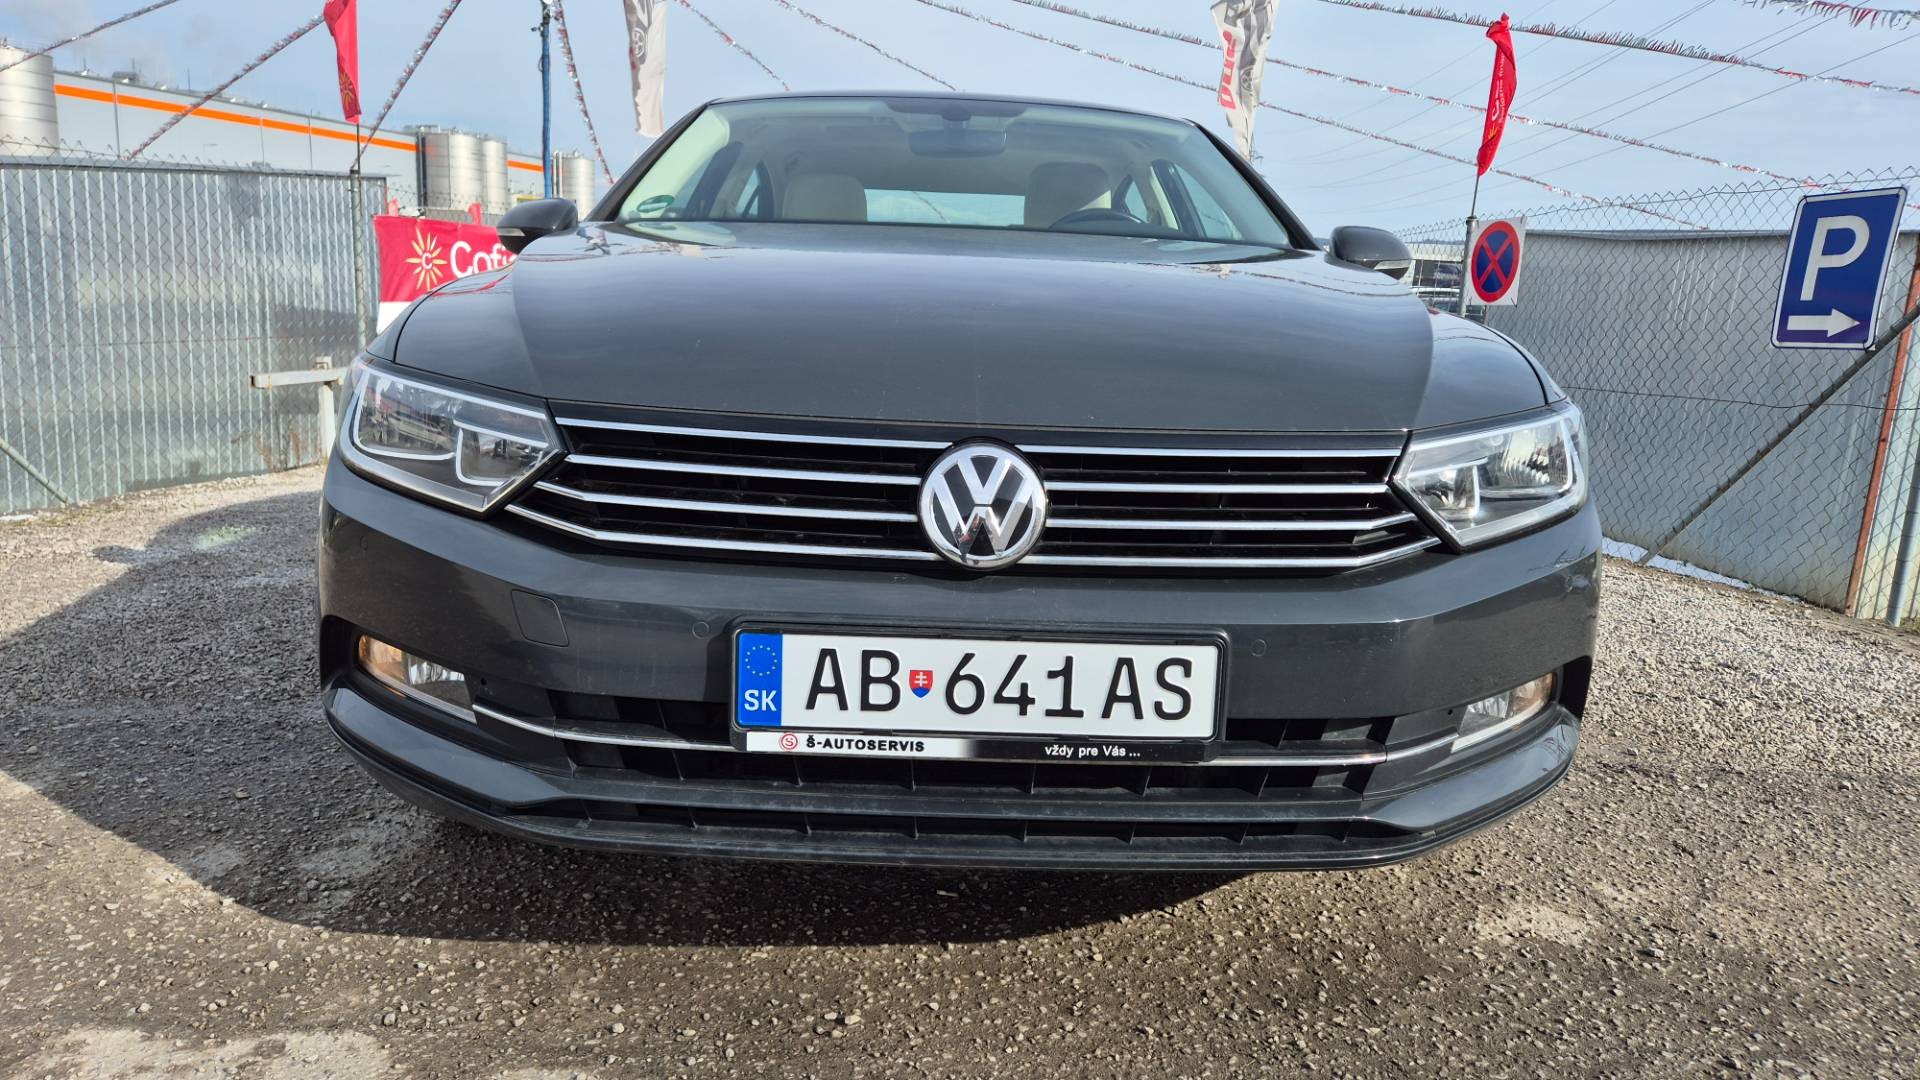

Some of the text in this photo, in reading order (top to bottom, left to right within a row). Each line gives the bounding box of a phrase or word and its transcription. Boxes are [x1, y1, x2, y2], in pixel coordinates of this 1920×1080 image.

[450, 240, 518, 278] Cof
[1800, 215, 1870, 301] P
[922, 446, 1045, 567] VW
[805, 648, 901, 712] AB
[744, 689, 777, 712] SK
[806, 735, 925, 752] Š-AUTOSERVIS
[1045, 745, 1074, 758] vždy
[1079, 748, 1098, 758] pre
